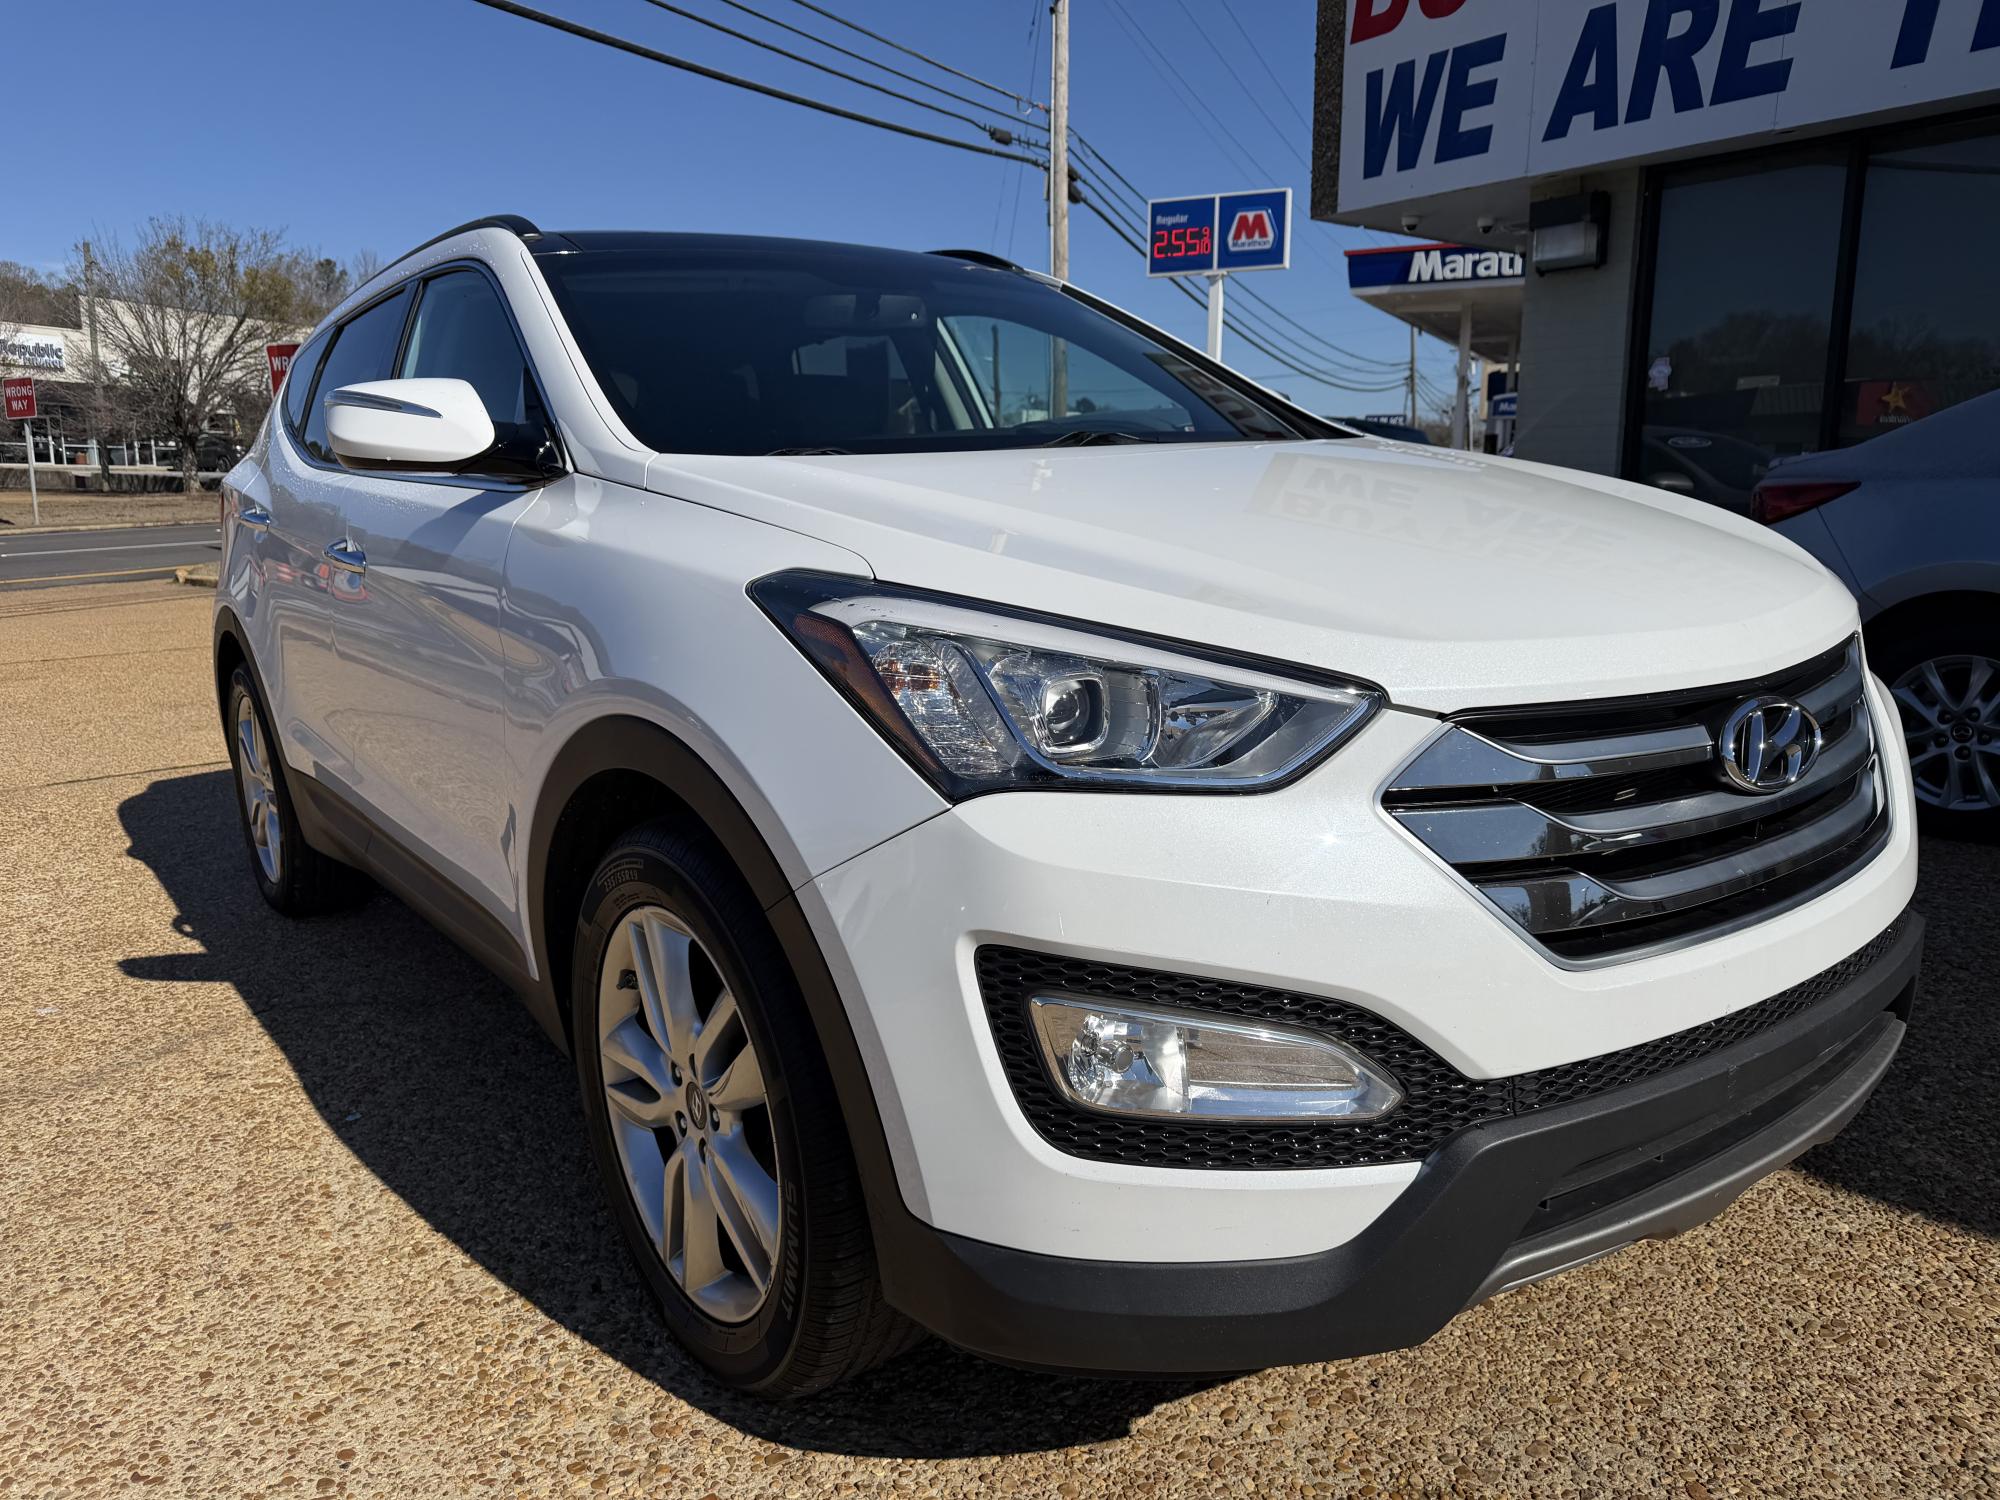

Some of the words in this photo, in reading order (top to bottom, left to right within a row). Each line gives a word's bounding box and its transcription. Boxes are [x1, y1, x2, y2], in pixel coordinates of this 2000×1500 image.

[1363, 32, 1507, 180] WE
[1541, 0, 1803, 143] ARE
[1155, 213, 1189, 226] Regular
[1232, 238, 1271, 249] Marathon
[5, 385, 33, 398] WRONG
[11, 399, 28, 411] WAY
[781, 1180, 800, 1321] SUMMIT
